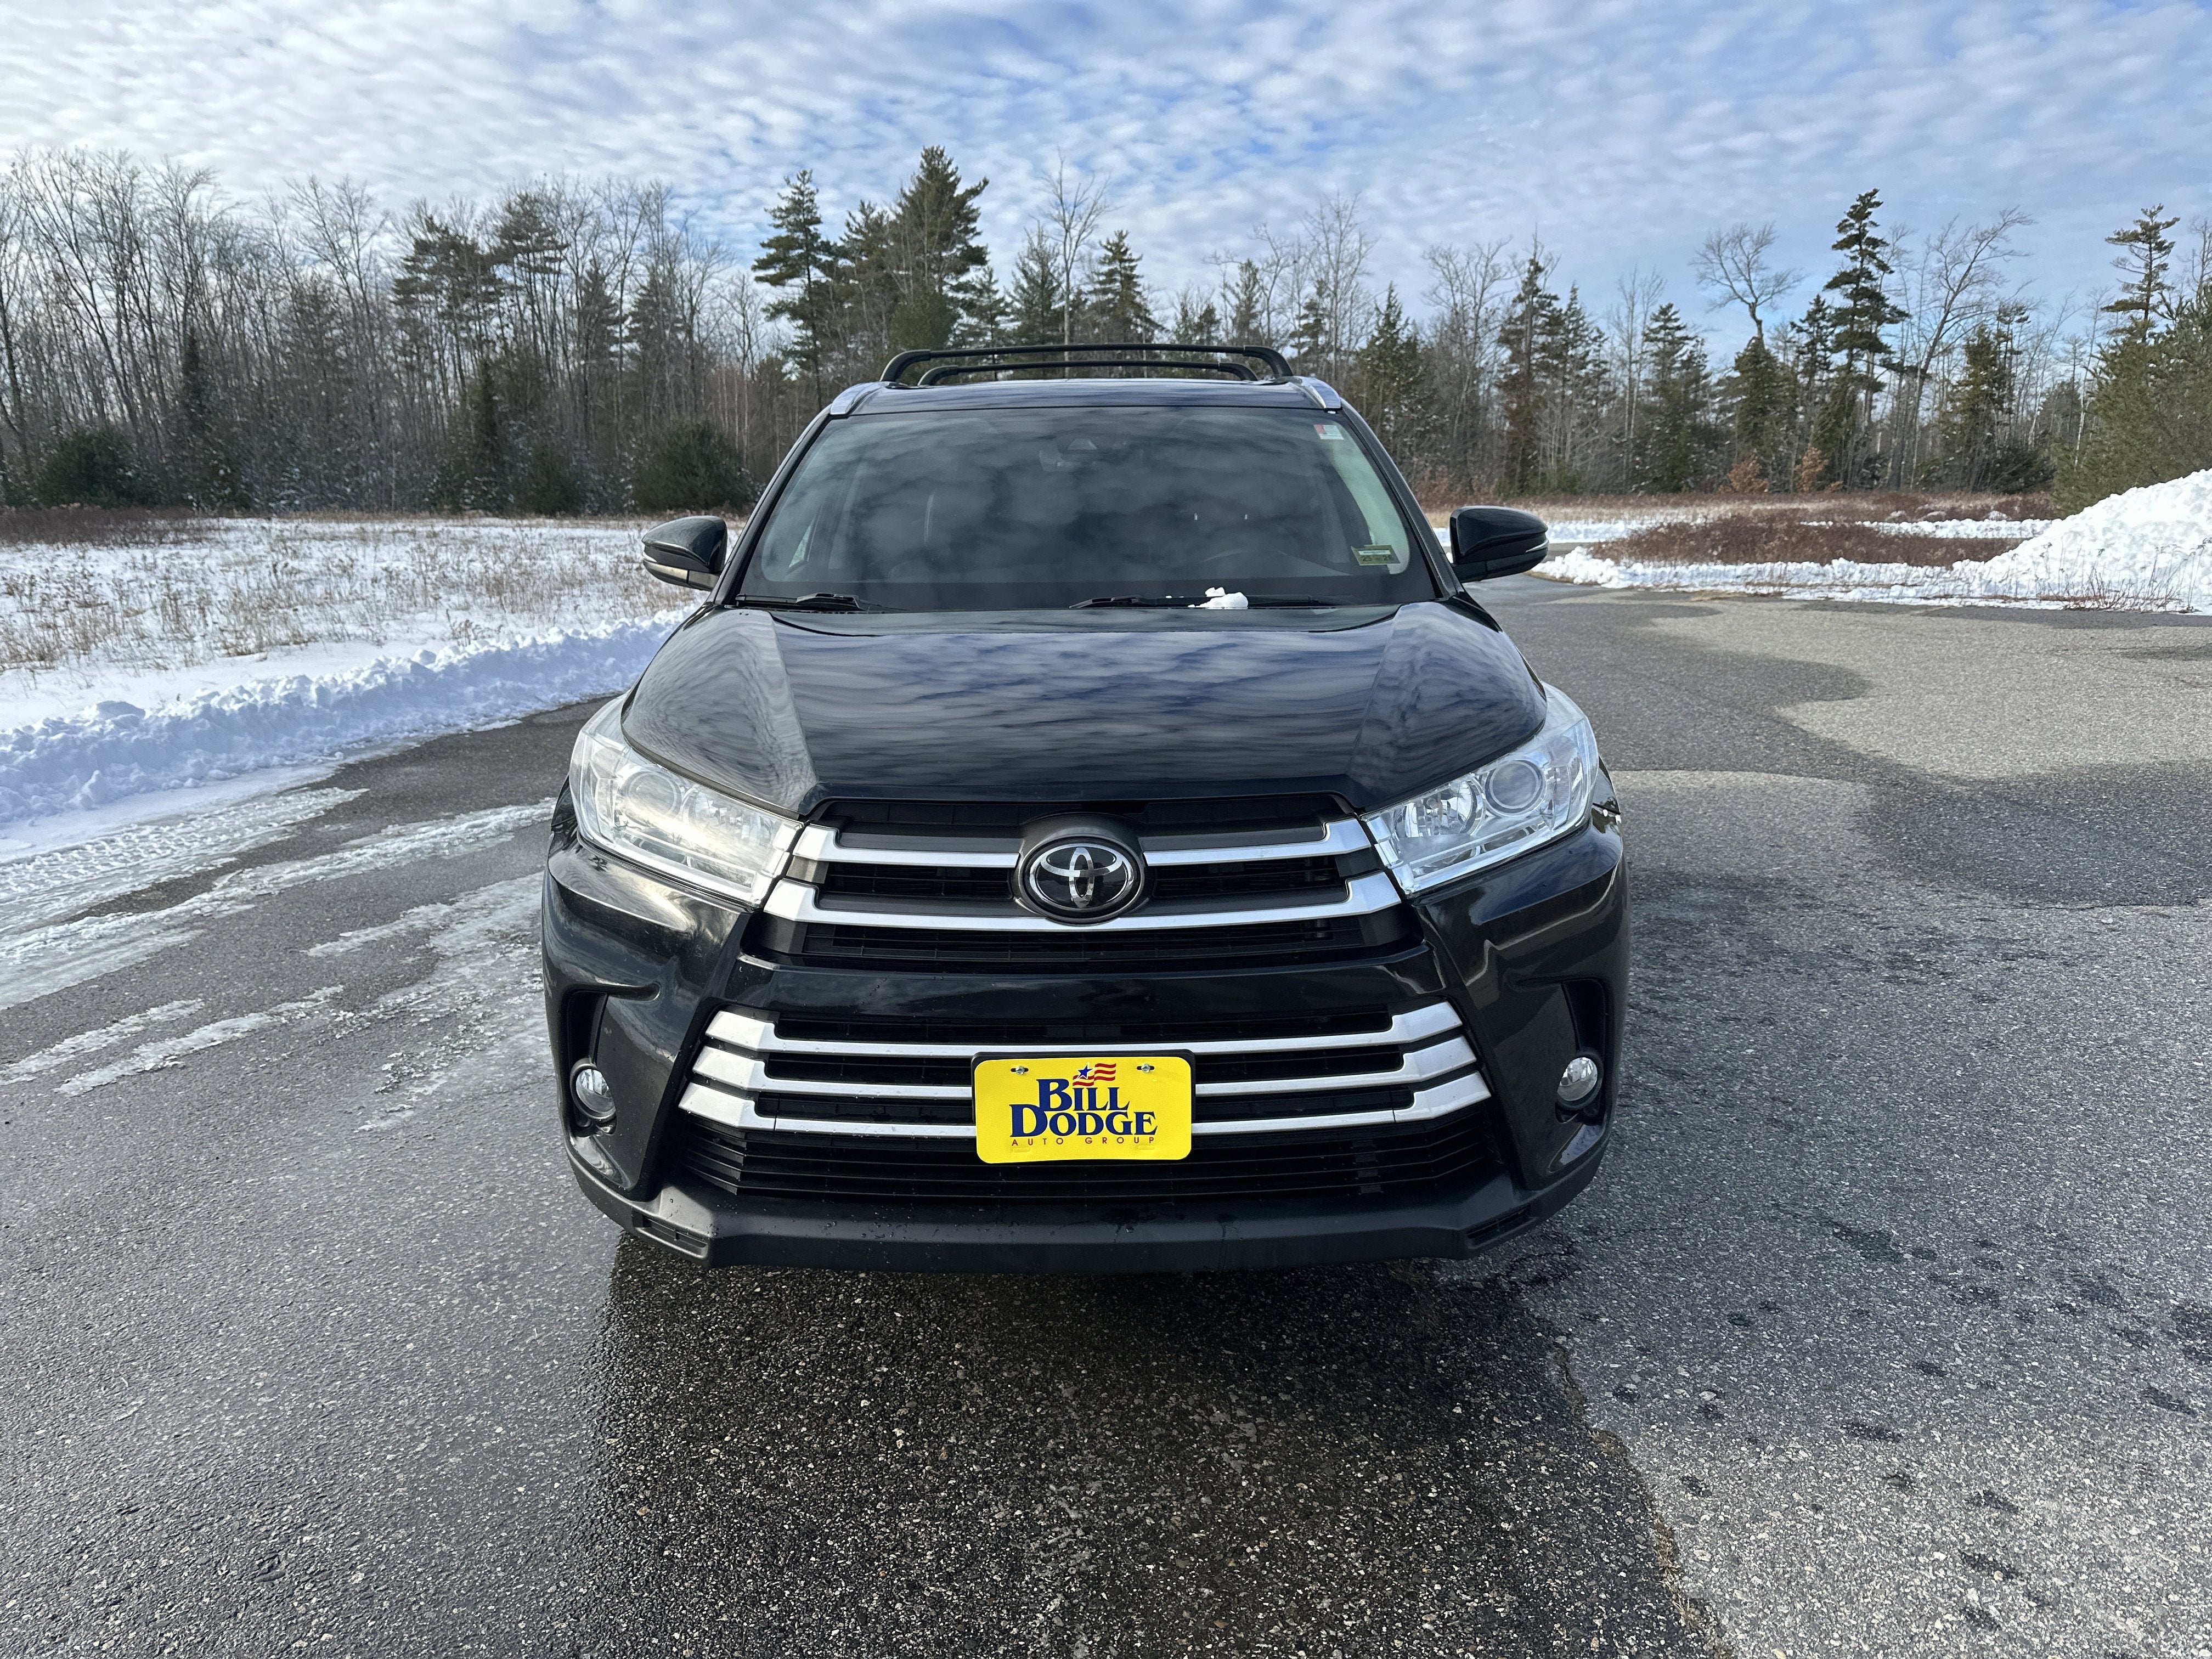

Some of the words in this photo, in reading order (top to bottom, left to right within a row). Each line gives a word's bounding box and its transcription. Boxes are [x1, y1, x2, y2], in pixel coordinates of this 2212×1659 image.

[1036, 1078, 1130, 1111] BILL
[1009, 1104, 1158, 1138] DODGE
[1011, 1137, 1064, 1147] AUTO
[1085, 1136, 1154, 1144] GROUP
